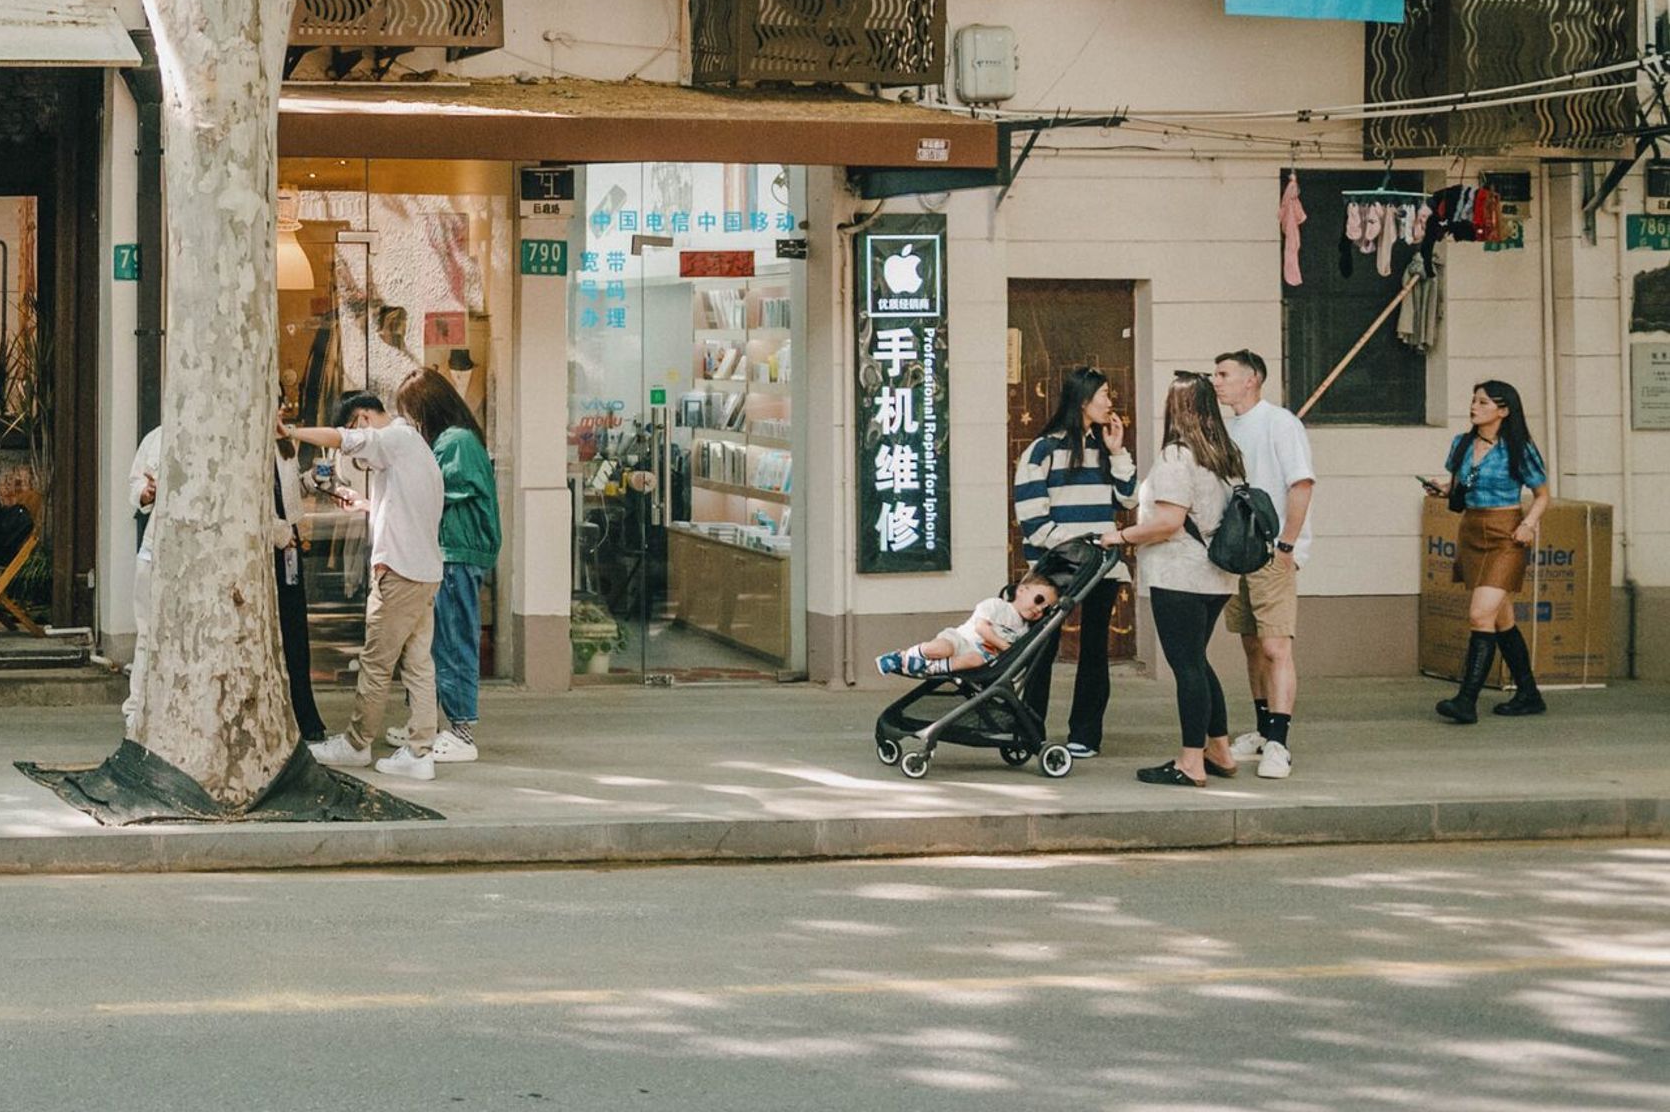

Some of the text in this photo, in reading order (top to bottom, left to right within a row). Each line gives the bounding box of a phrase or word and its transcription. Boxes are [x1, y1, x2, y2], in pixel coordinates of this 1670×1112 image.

[528, 243, 561, 262] 790
[923, 328, 936, 420] Professional
[873, 326, 920, 553] 手机维修
[923, 422, 937, 471] Repair
[924, 473, 938, 495] for
